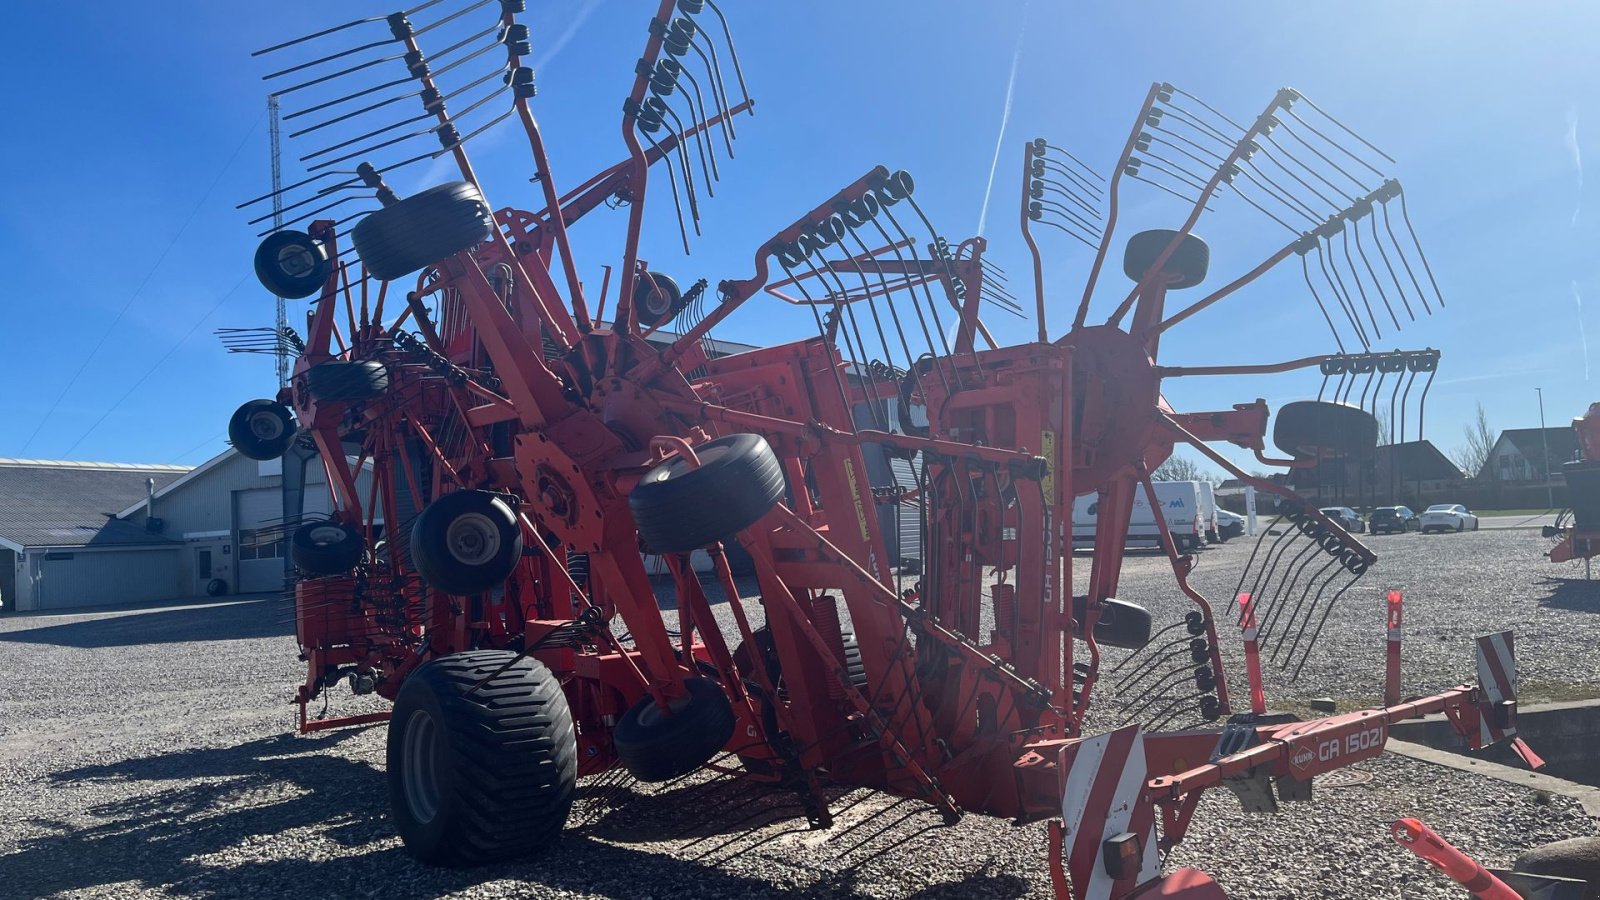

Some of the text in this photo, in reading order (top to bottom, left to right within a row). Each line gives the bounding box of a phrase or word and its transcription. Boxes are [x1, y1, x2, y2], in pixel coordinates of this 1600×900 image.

[1319, 727, 1383, 761] GA 15021
[1294, 752, 1313, 764] KUHN
